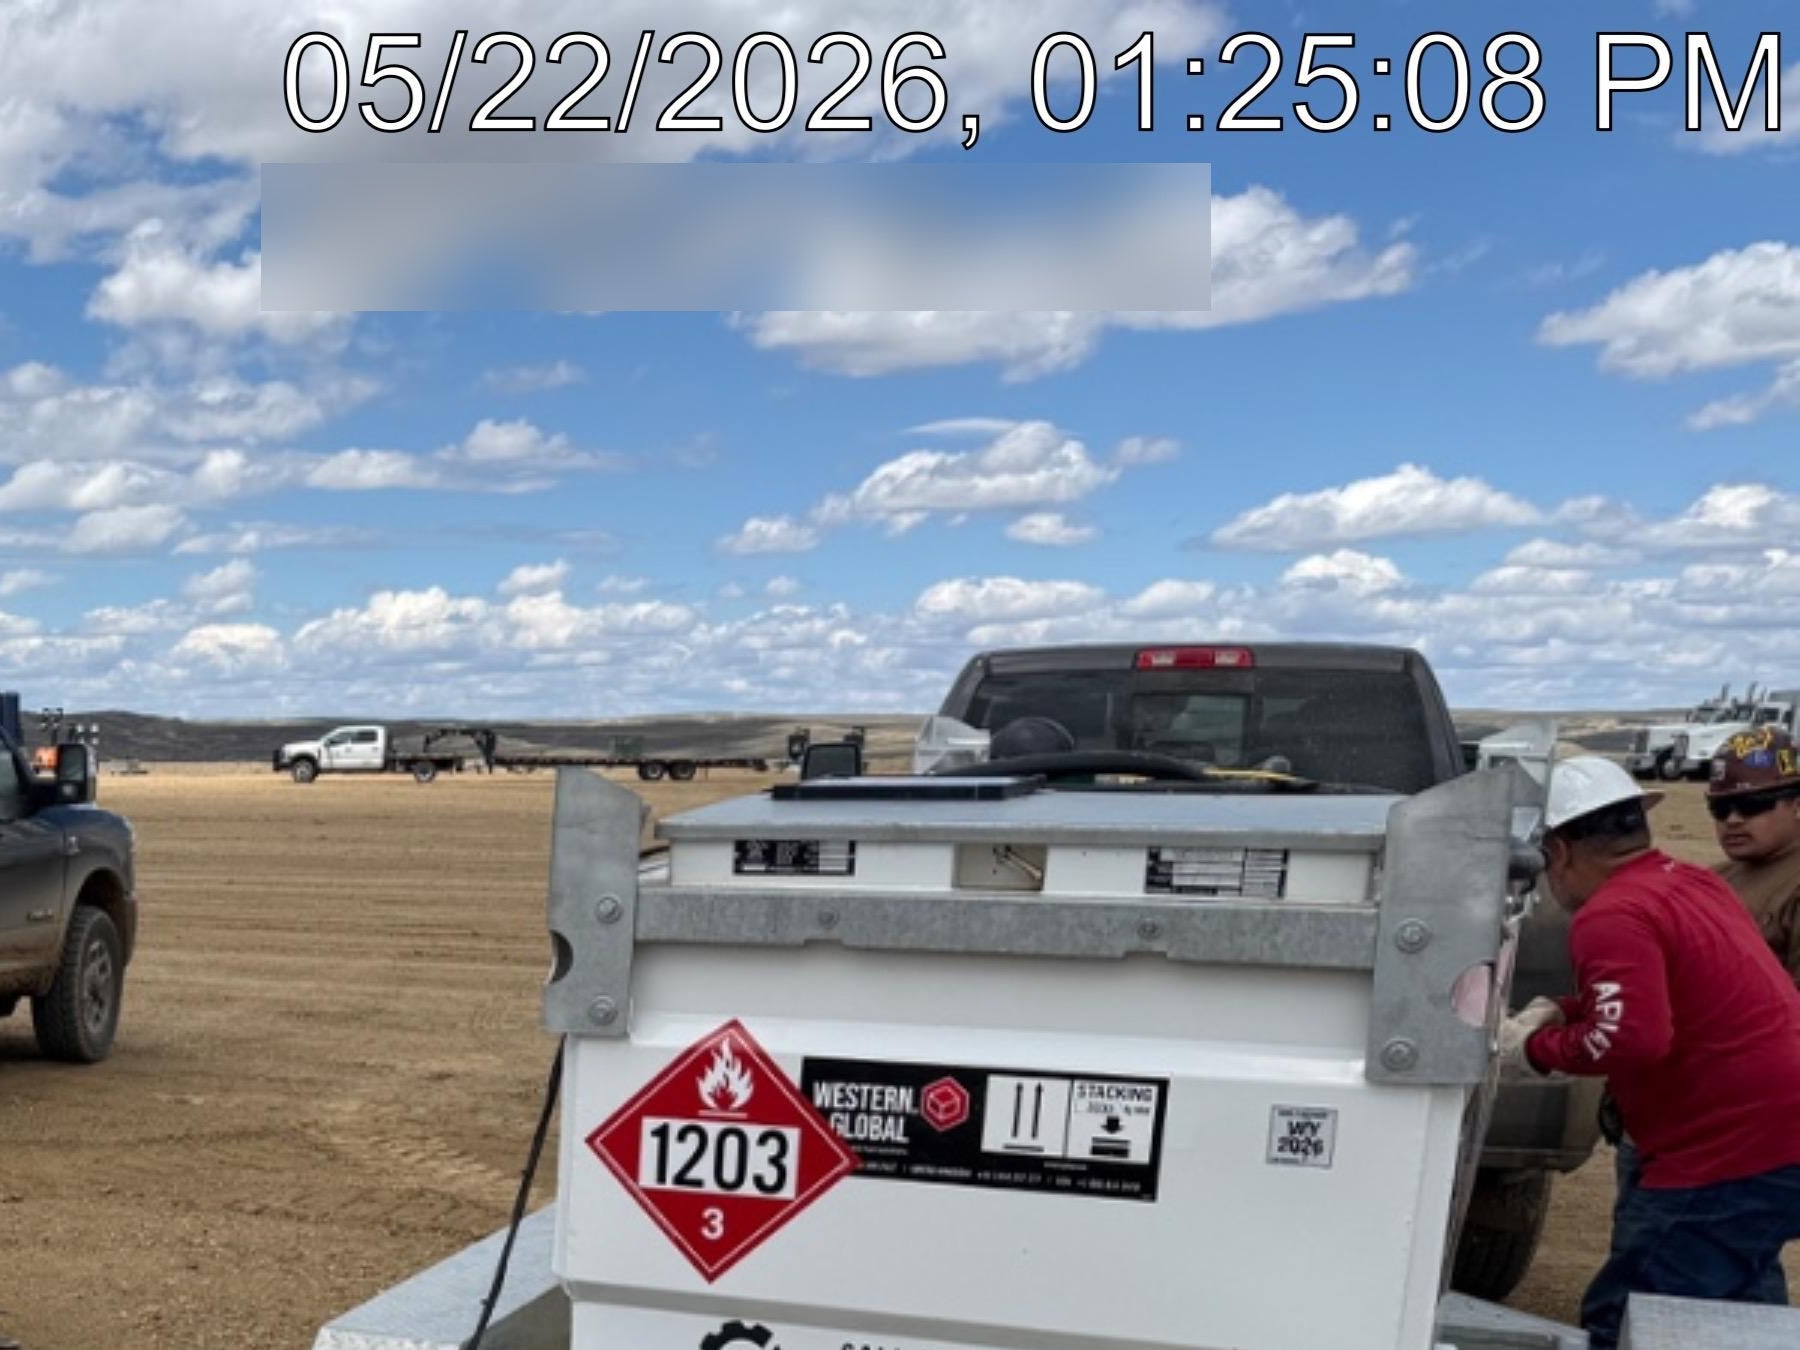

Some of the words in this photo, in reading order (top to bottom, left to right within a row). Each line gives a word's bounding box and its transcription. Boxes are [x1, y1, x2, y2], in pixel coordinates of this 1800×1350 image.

[812, 1081, 914, 1113] WESTERN
[1076, 1084, 1153, 1102] STACKING
[830, 1111, 909, 1144] GLOBAL
[650, 1121, 789, 1195] 1203
[701, 1206, 725, 1241] 3
